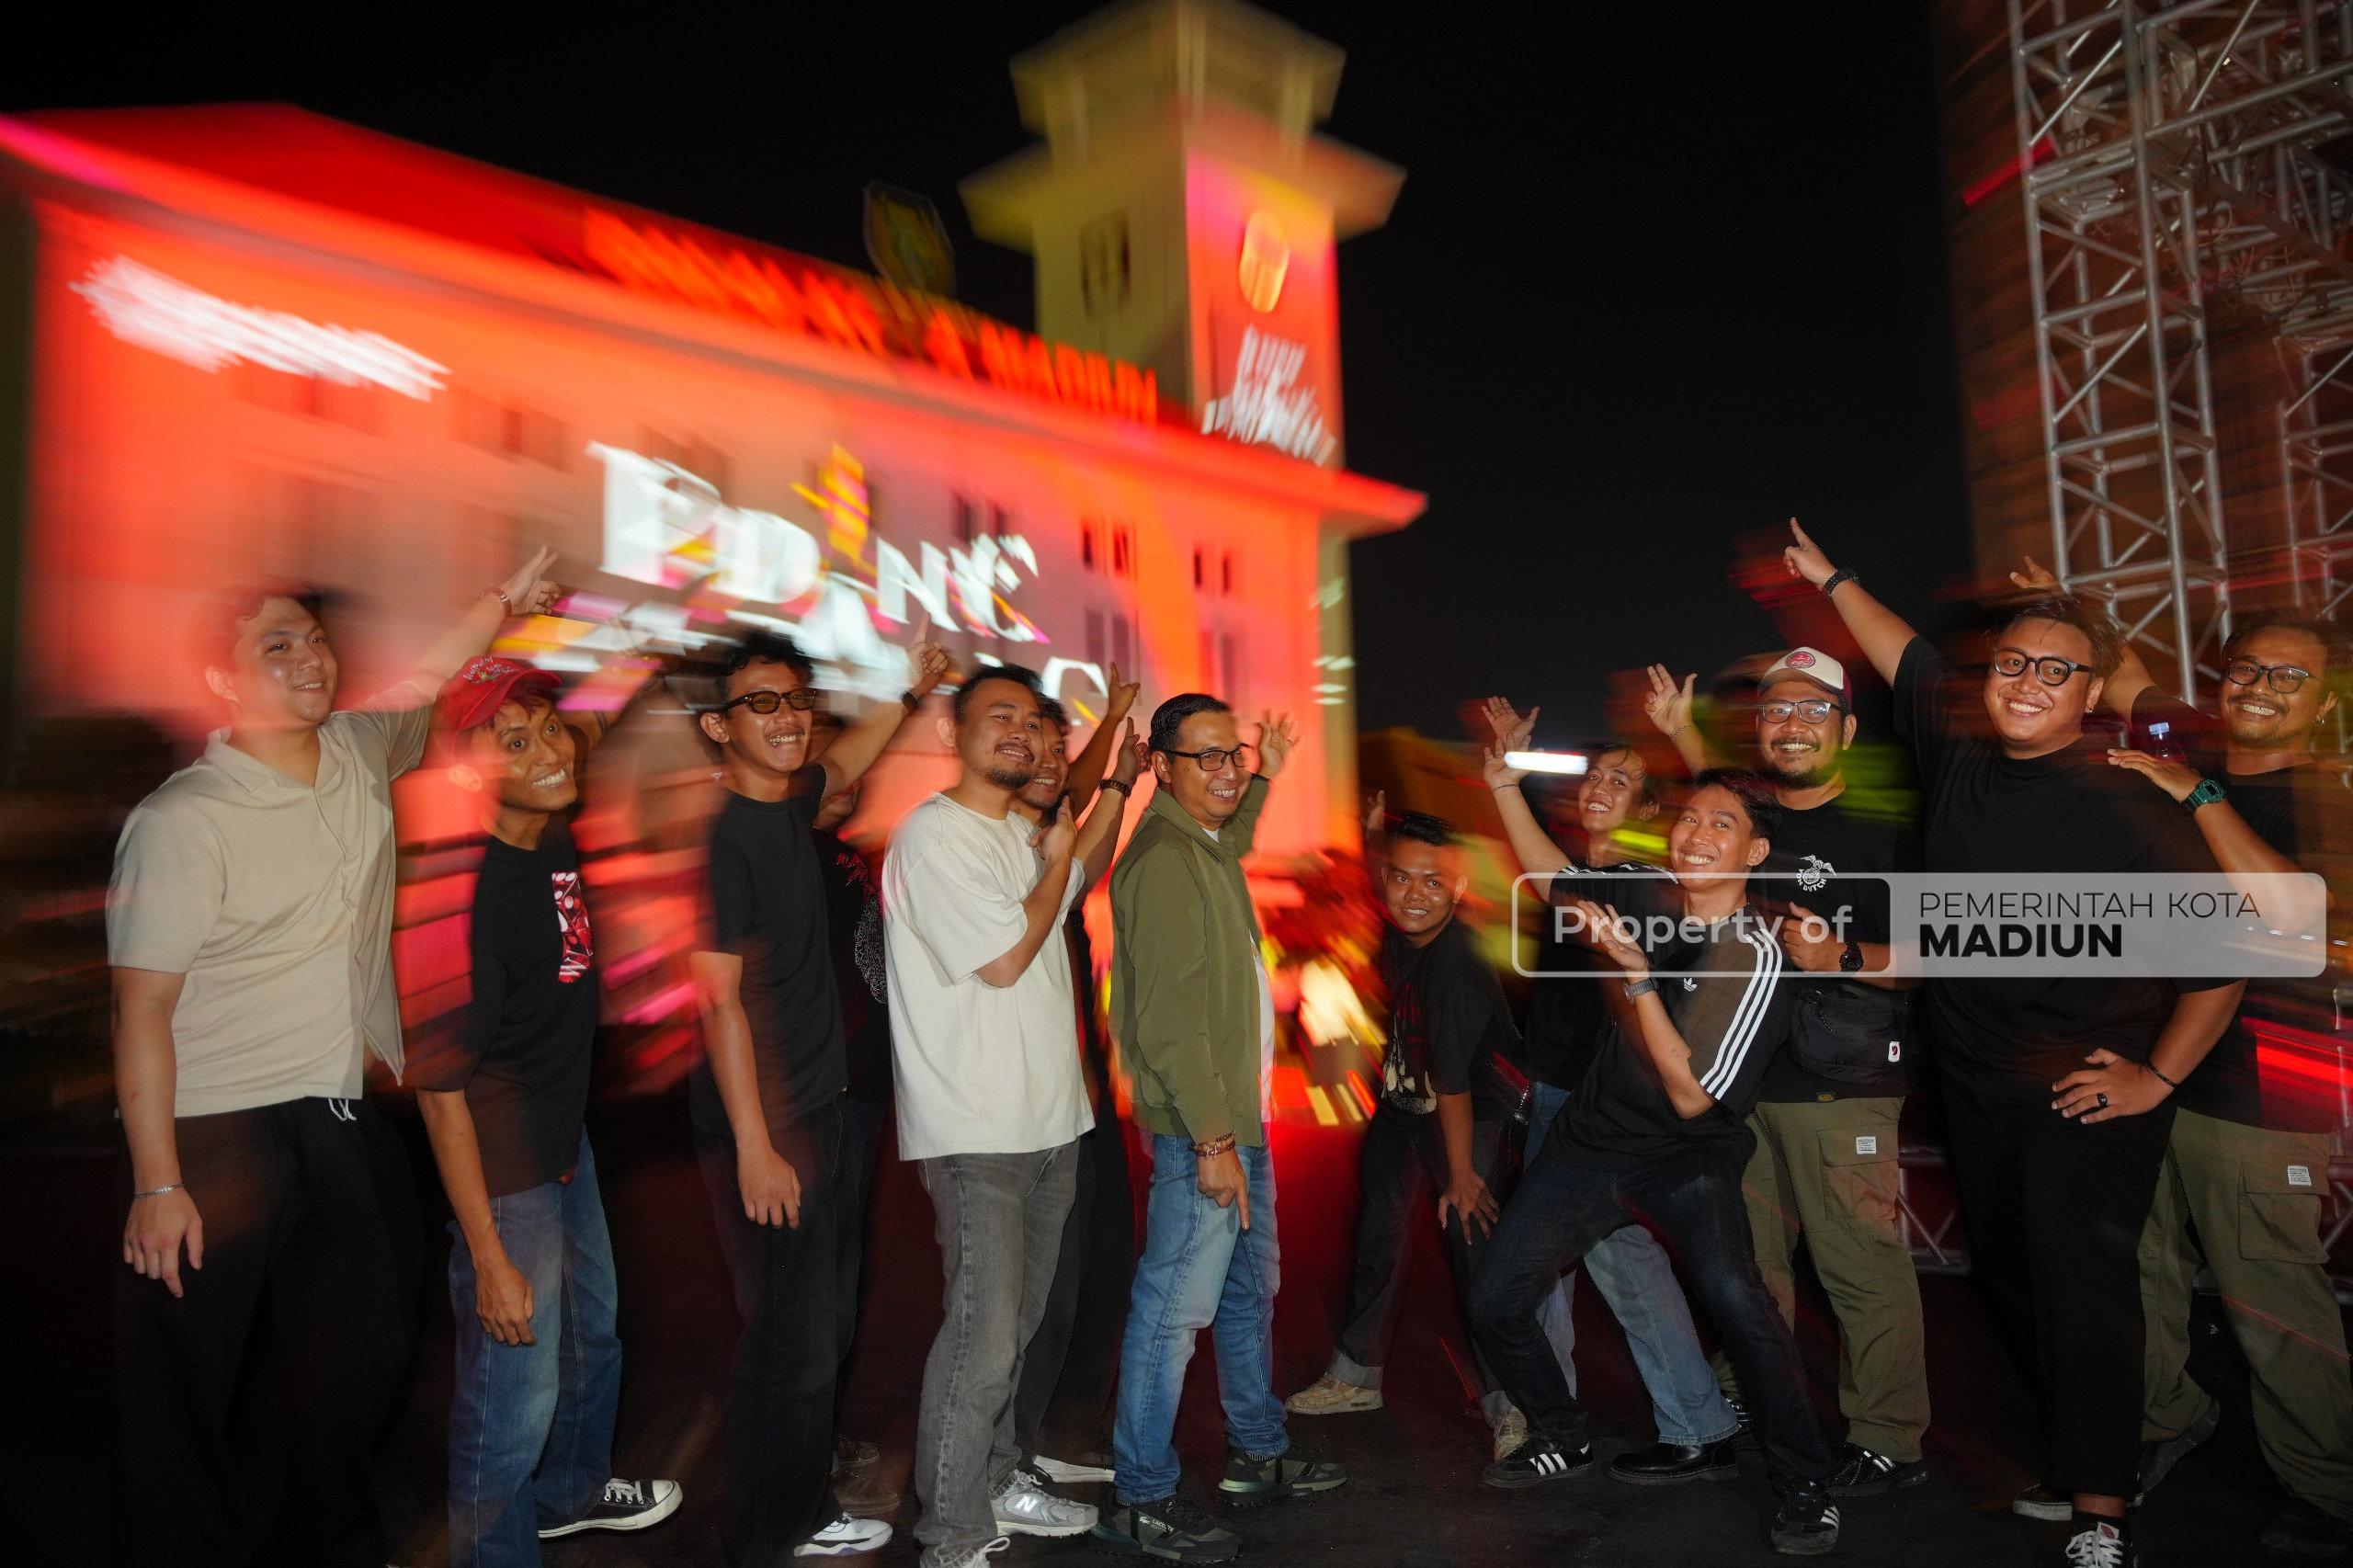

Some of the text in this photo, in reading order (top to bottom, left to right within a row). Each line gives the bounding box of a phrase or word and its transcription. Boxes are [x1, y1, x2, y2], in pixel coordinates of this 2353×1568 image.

[1795, 869, 1804, 886] VON
[1802, 879, 1826, 892] DUTCH
[1152, 1518, 1175, 1533] LACOTE
